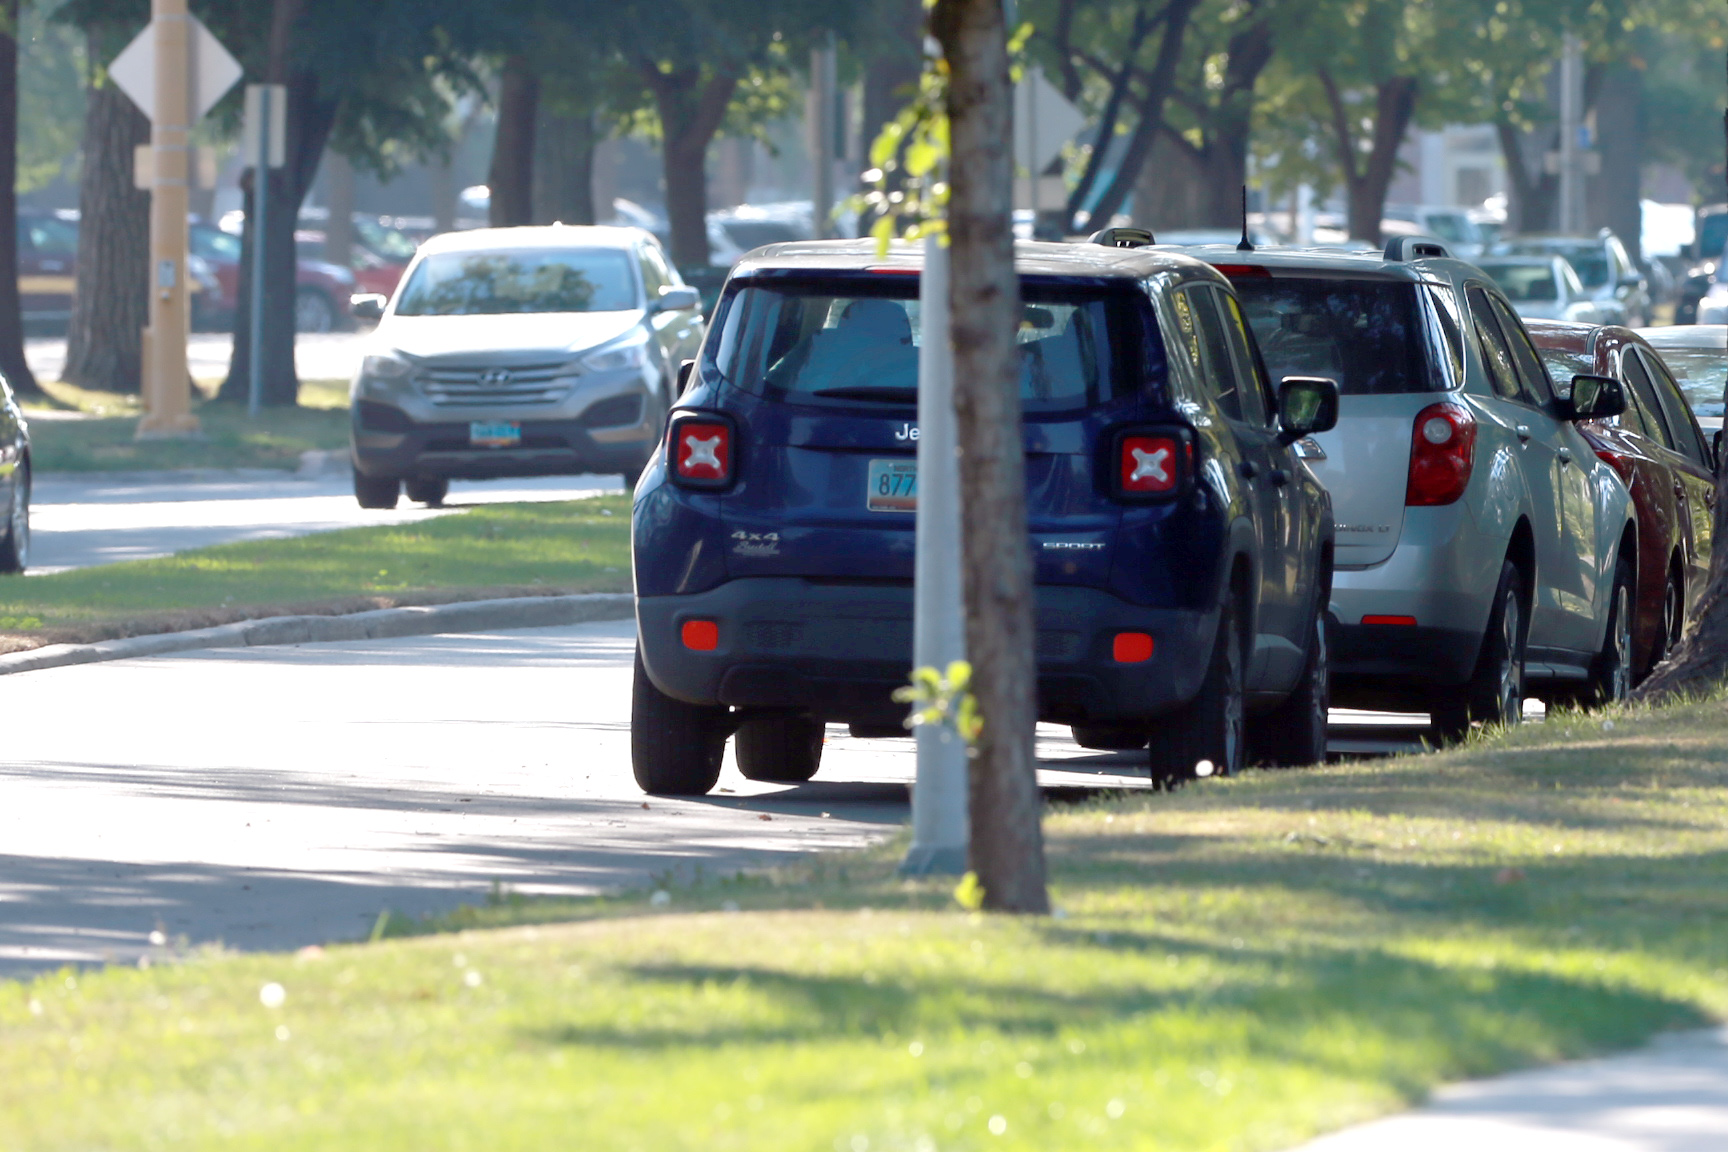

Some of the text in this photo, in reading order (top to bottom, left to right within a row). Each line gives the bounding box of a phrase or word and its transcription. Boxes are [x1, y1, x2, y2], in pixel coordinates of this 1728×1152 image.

[895, 422, 920, 441] Je
[878, 473, 917, 497] 877
[1043, 542, 1106, 550] SPORT
